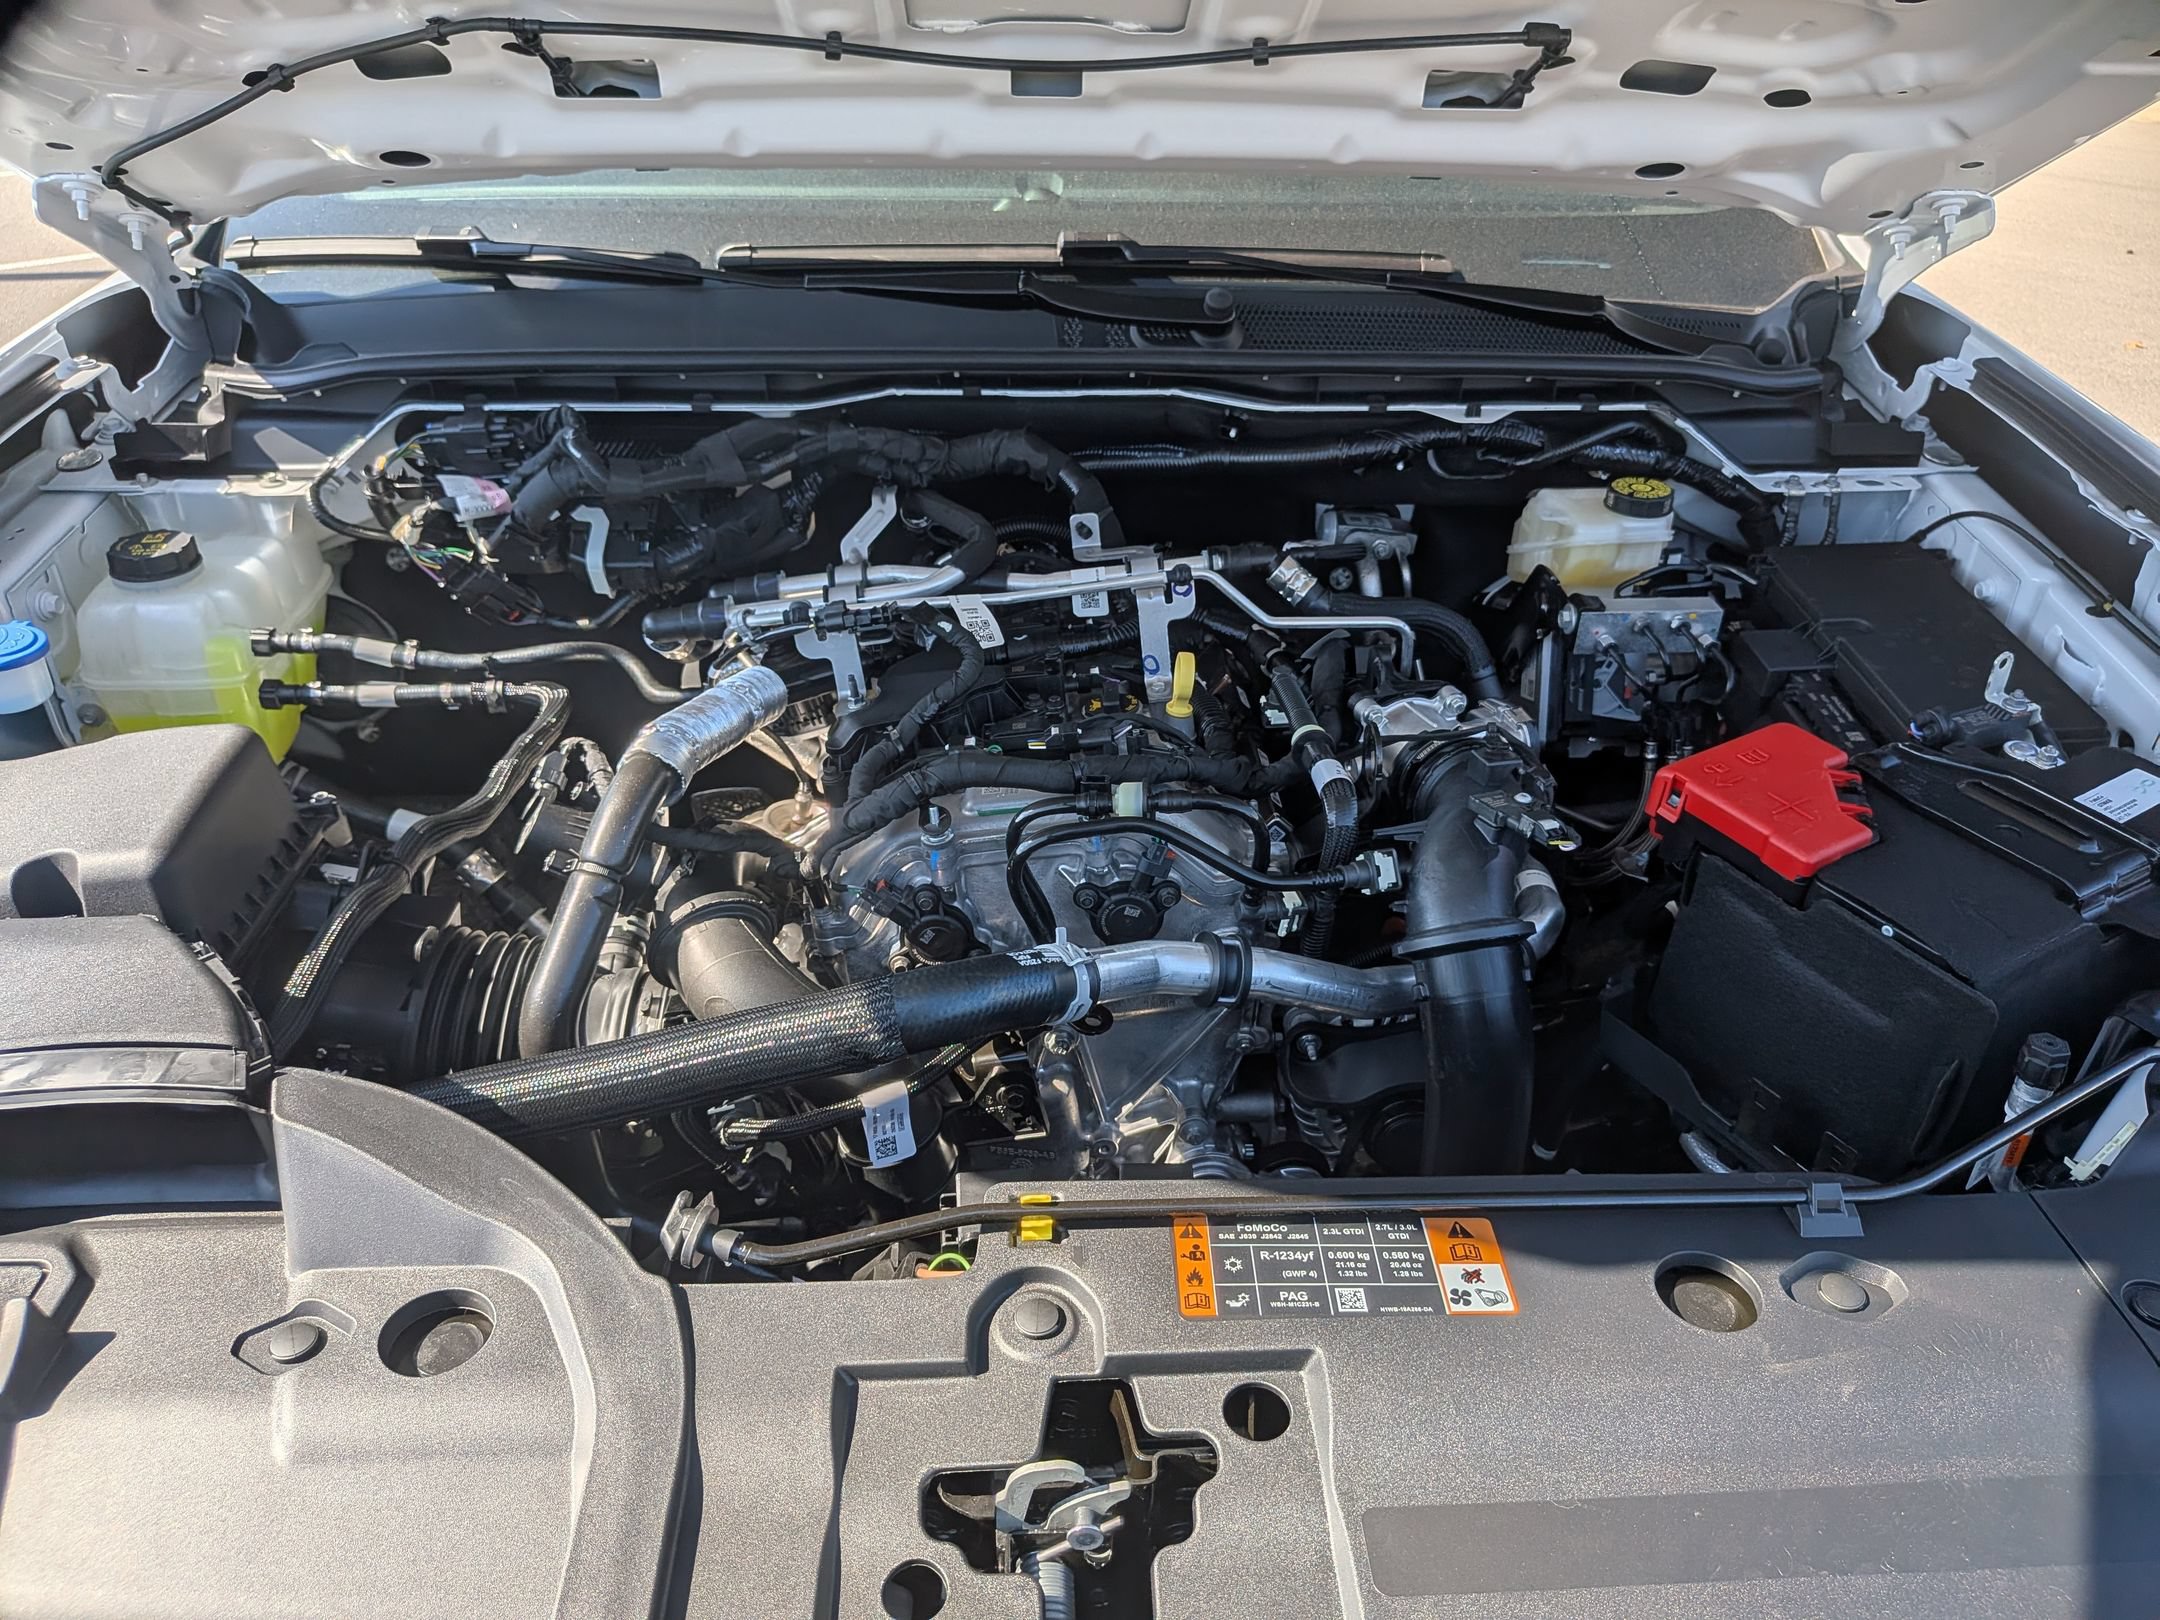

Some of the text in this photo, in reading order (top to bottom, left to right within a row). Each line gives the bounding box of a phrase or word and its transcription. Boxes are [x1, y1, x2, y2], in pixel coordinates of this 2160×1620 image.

[1236, 1223, 1288, 1232] FoMoCo
[1387, 1232, 1410, 1240] GTDI
[1260, 1251, 1315, 1262] R-1234yf
[1327, 1251, 1370, 1260] 0.600 kg
[1382, 1251, 1425, 1260] 0.580 kg
[1282, 1270, 1318, 1279] (GWP 4)
[1279, 1291, 1309, 1301] PAG
